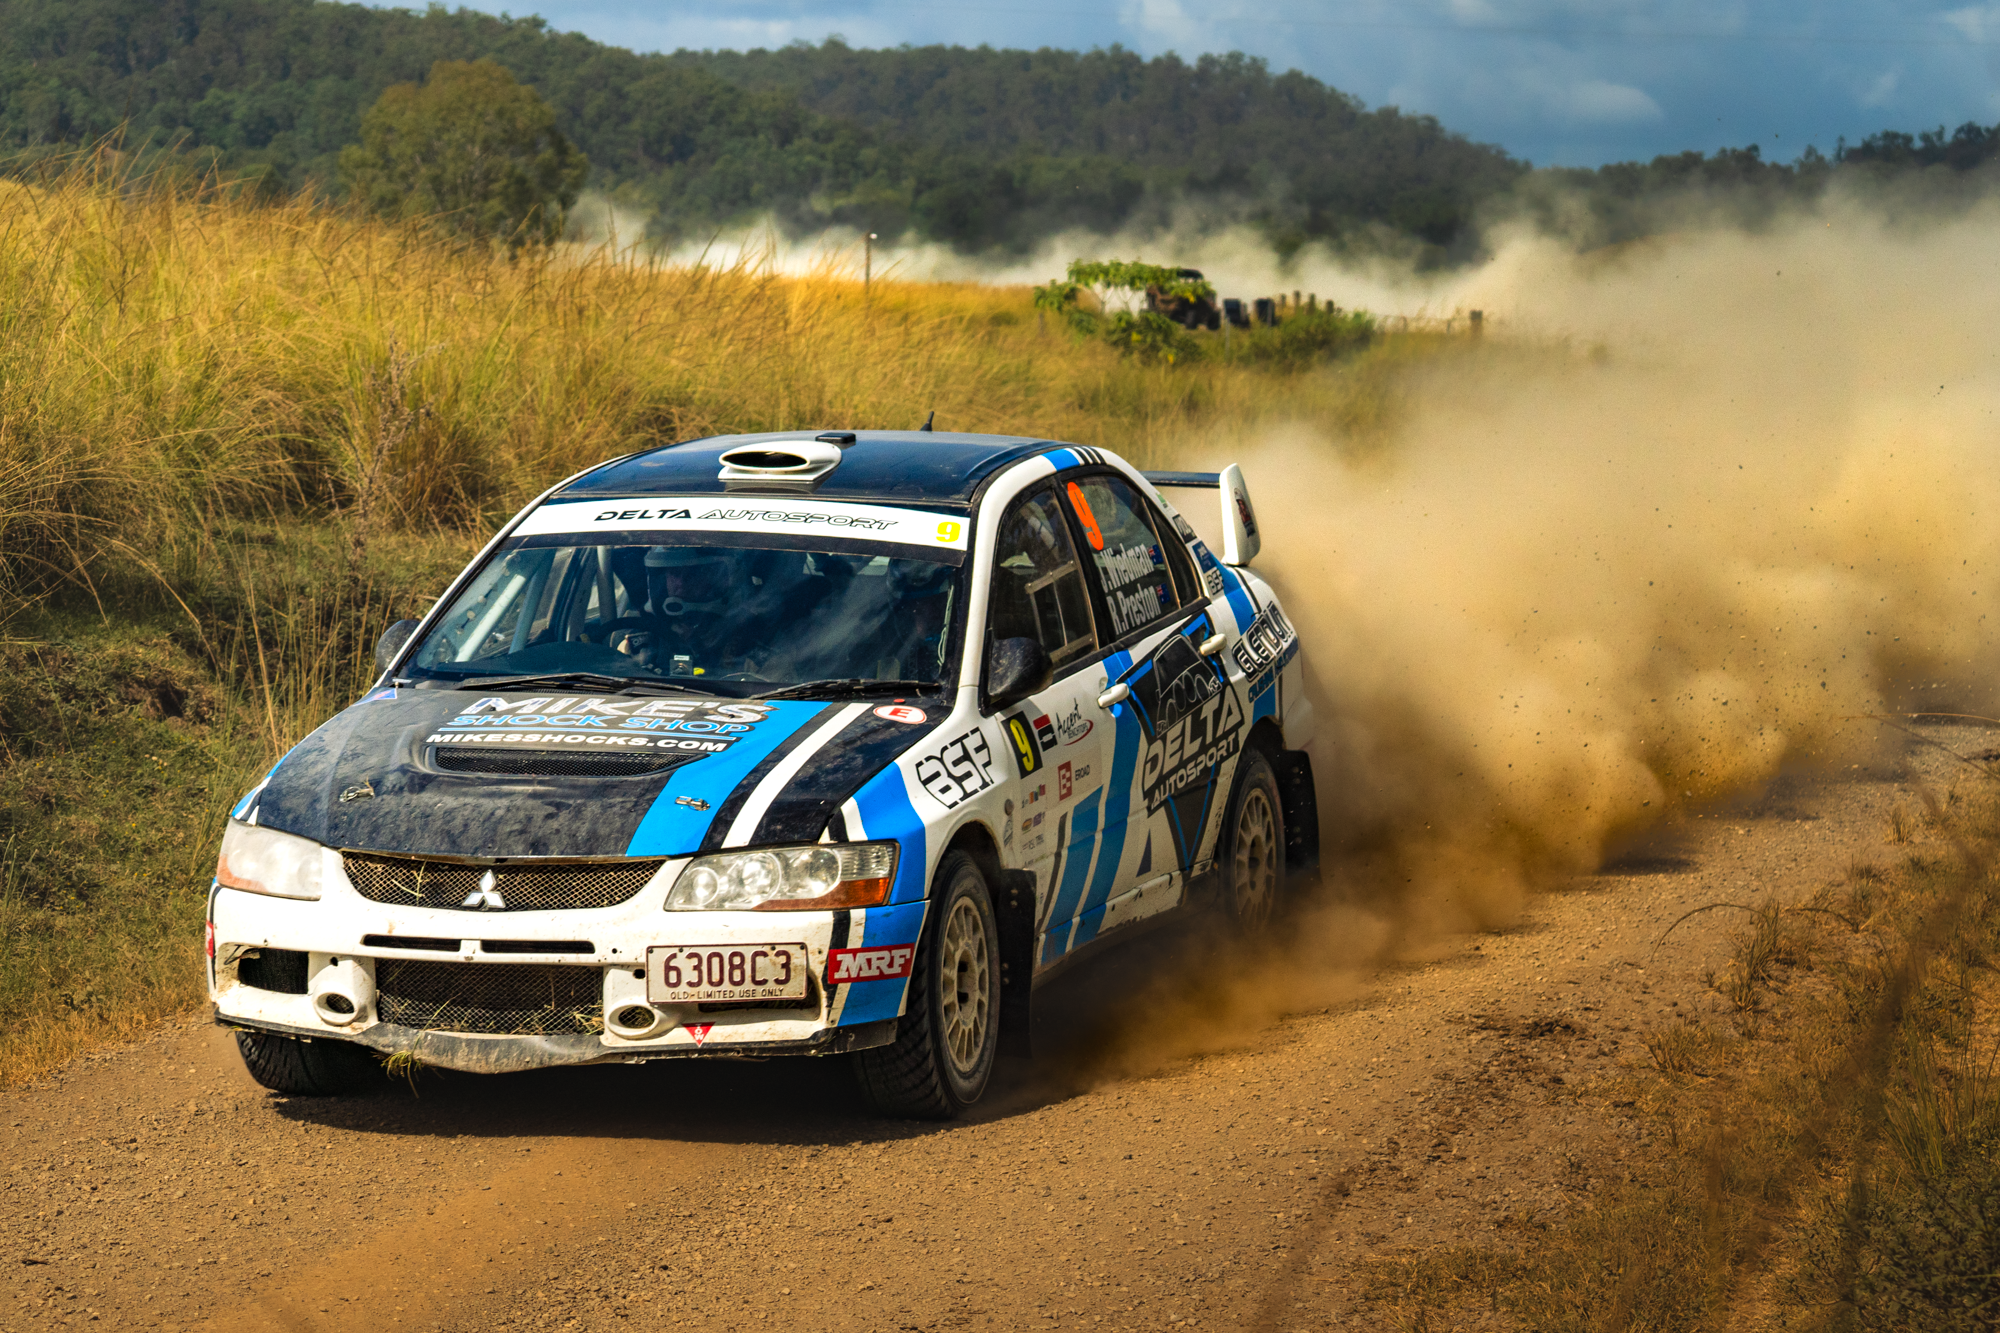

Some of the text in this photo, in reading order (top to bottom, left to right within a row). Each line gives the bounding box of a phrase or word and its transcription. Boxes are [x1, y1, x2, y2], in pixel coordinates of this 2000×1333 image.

[594, 508, 899, 531] DELTA AUTOSPORT
[936, 521, 961, 543] 9
[1067, 481, 1104, 551] 9
[1106, 582, 1162, 636] R.Preston
[446, 714, 751, 737] SHOCK SHOP
[459, 697, 773, 723] MIKE'S
[888, 707, 913, 719] E
[1055, 697, 1082, 739] Accent
[425, 733, 728, 752] MIKESSHOCKS.COM
[1009, 718, 1035, 772] 9
[1144, 684, 1243, 793] DELTA
[914, 726, 995, 810] BSF
[1150, 731, 1238, 810] AUTOSPORT
[664, 949, 792, 988] 6308C3
[834, 948, 911, 979] MRF
[739, 988, 756, 998] USE
[761, 986, 784, 997] ONLY
